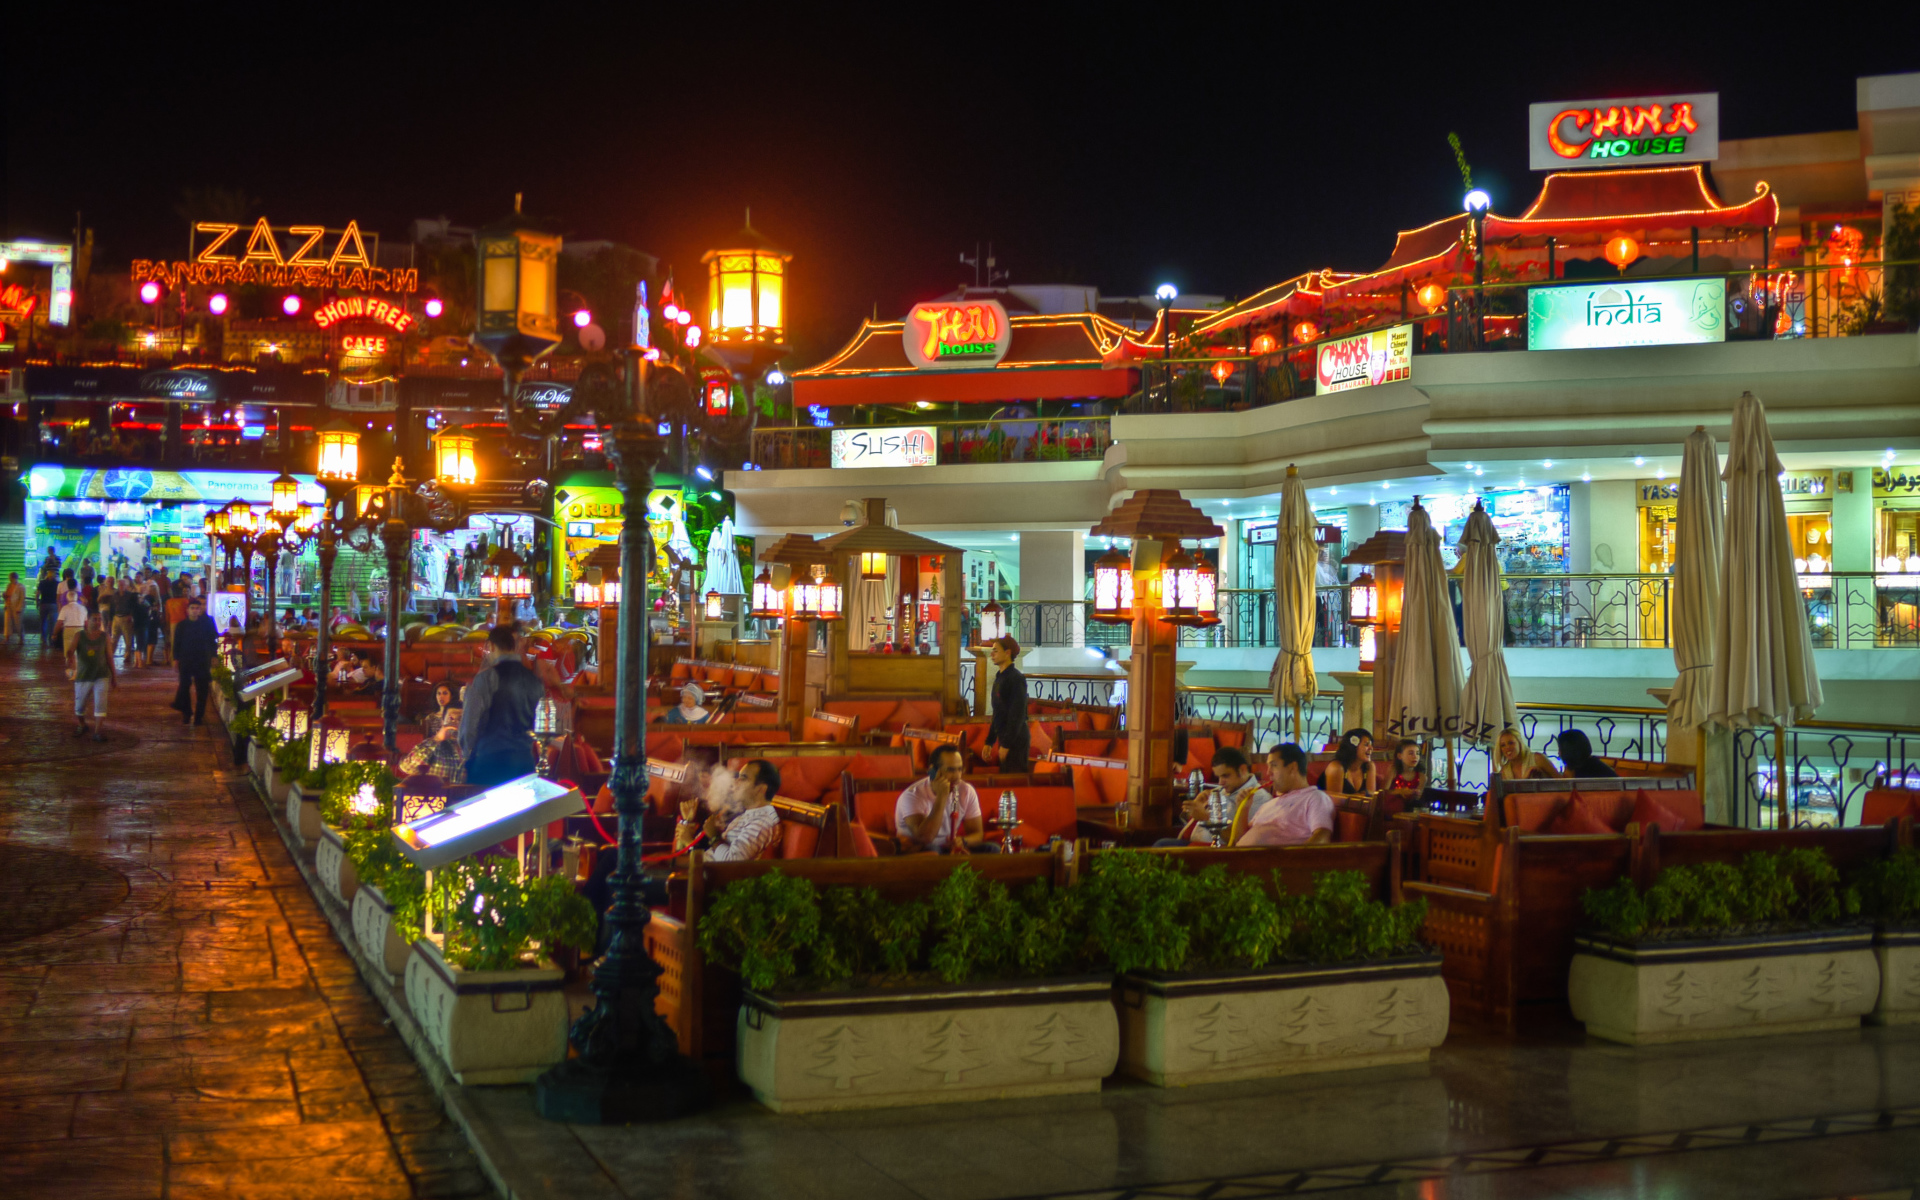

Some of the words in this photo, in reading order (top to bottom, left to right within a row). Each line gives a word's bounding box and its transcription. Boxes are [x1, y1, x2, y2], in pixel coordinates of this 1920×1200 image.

[1548, 102, 1698, 159] CHINA
[1590, 136, 1686, 159] HOUSE
[197, 216, 369, 273] ZAZA
[313, 297, 363, 329] SHOW
[365, 298, 412, 332] FREE
[914, 305, 997, 360] THAI
[342, 336, 387, 352] CAFE
[939, 341, 996, 355] house
[1318, 336, 1370, 387] CHINA
[1335, 363, 1367, 379] HOUSE
[1329, 377, 1369, 391] RESTAURANT
[851, 431, 925, 462] SUSHI
[208, 480, 259, 491] Panorama
[1641, 484, 1680, 500] YASS
[1782, 475, 1827, 494] ELLERY
[568, 502, 621, 518] ORBI
